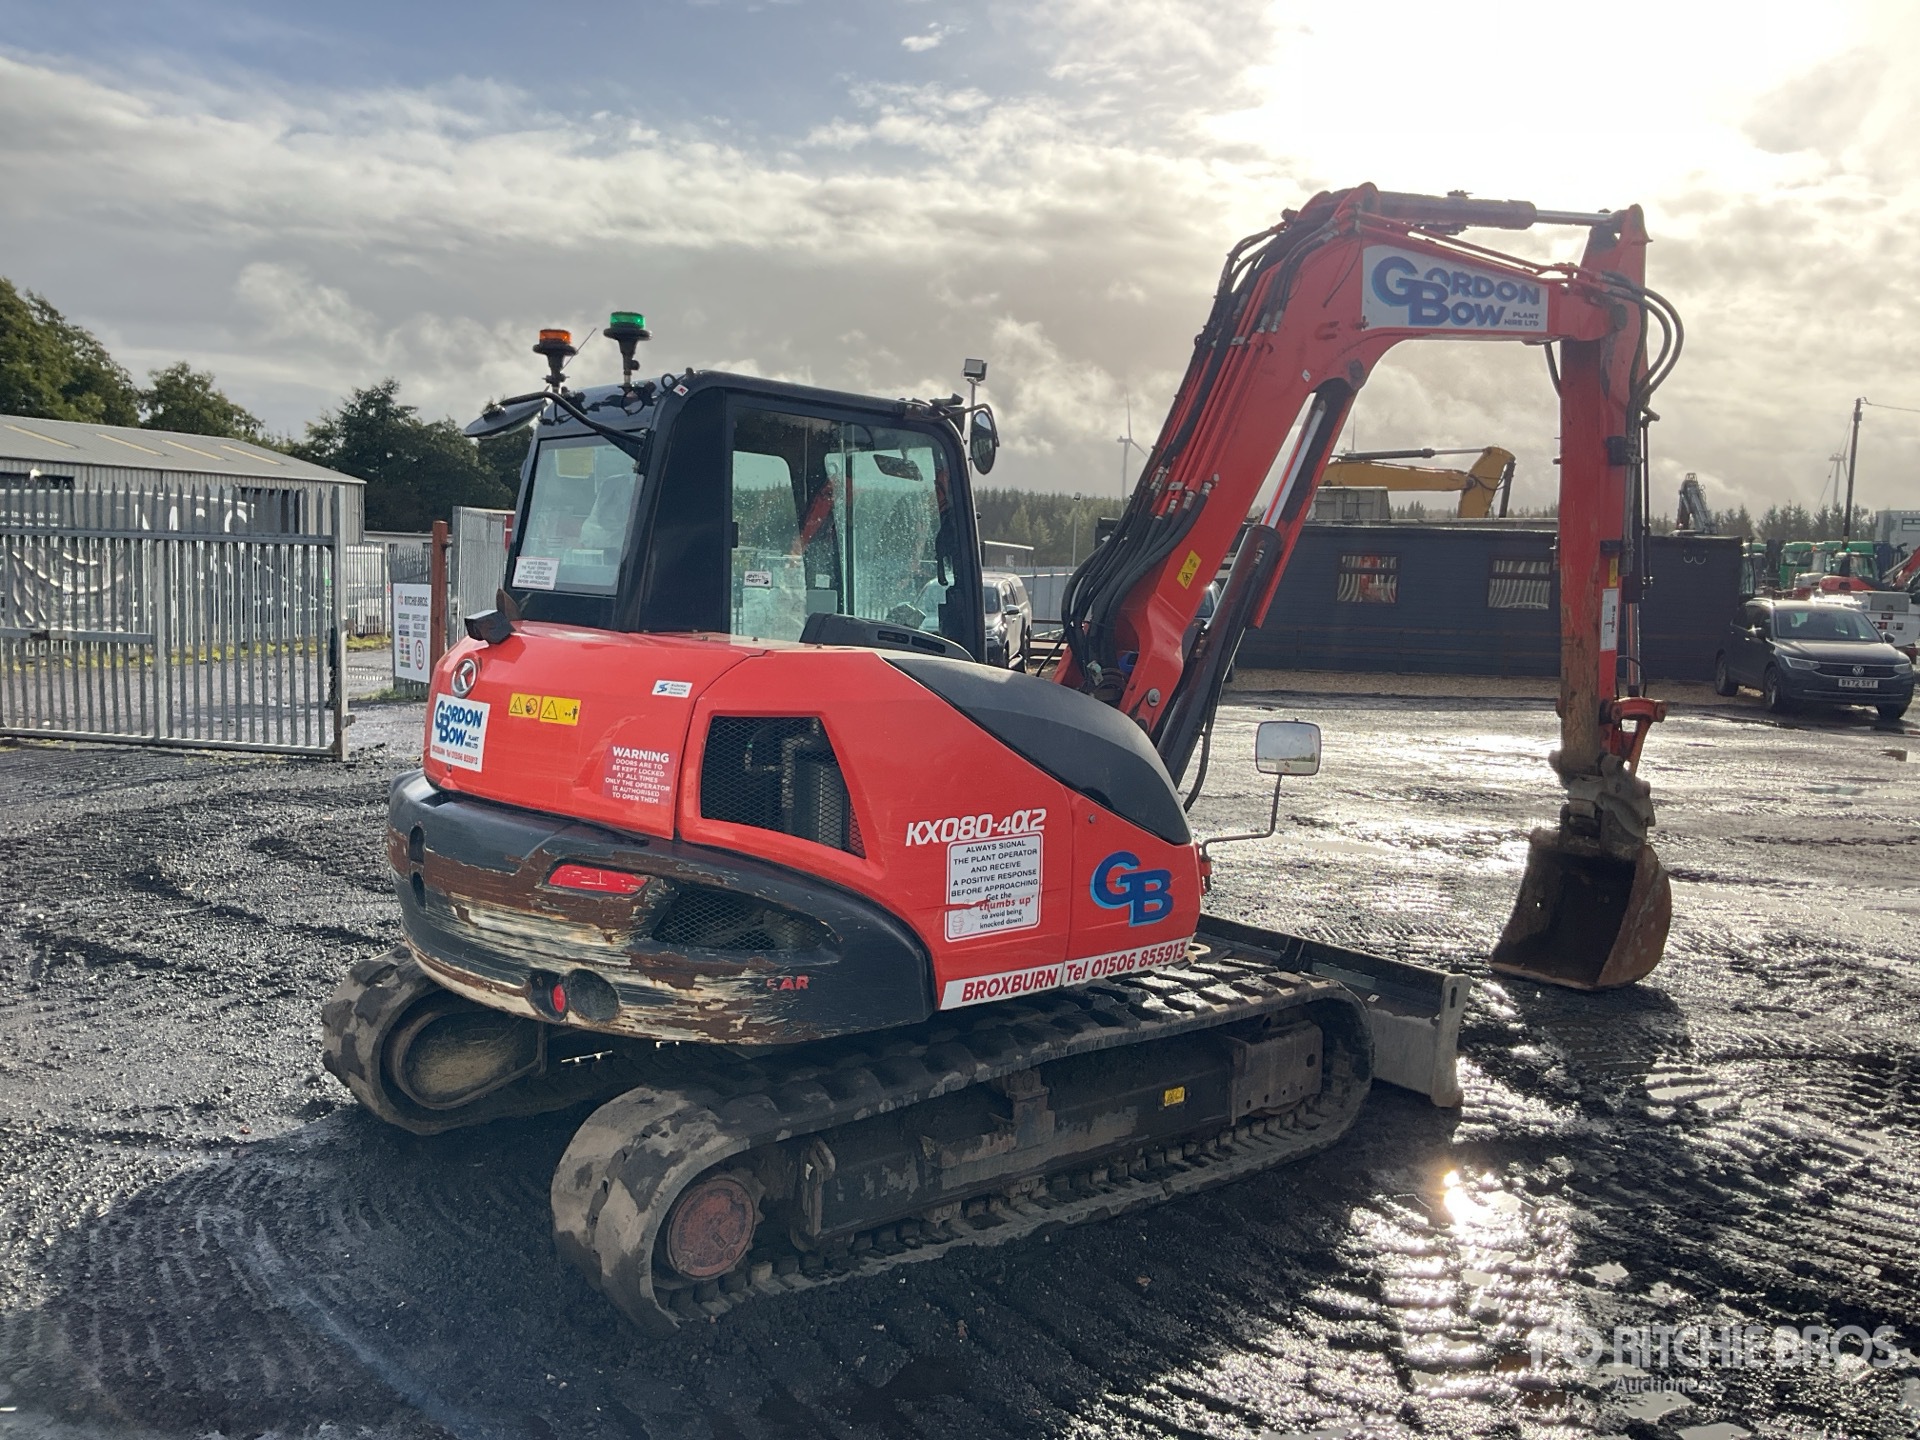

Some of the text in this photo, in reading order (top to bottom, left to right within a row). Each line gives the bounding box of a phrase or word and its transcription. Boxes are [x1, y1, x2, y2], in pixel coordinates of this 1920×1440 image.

[1371, 255, 1540, 307] GORDON
[1405, 277, 1506, 327] BOW
[1512, 311, 1539, 319] PLANT
[435, 700, 483, 729] GORDON
[439, 713, 467, 747] BOW
[612, 746, 670, 764] WARNING
[615, 758, 638, 767] DOORS
[638, 769, 665, 777] LOCKED
[639, 775, 658, 783] TIMES
[605, 777, 671, 791] ONLY THE OPERATOR
[620, 786, 660, 797] AUTHORISED
[622, 793, 639, 801] OPEN
[640, 796, 659, 804] THEM
[965, 840, 1027, 853] ALWAYS SIGNAL
[953, 848, 1038, 865] THE PLANT OPERATOR
[970, 860, 1021, 873] AND RECEIVE
[960, 874, 995, 886] POSITIVE
[997, 868, 1037, 880] RESPONSE
[951, 878, 1038, 897] BEFORE APPROACHING
[1090, 850, 1175, 928] GB
[986, 891, 1012, 901] Get the
[989, 911, 1005, 919] avoid
[1006, 908, 1022, 916] being
[980, 915, 1024, 929] knocked down!
[961, 940, 1188, 1002] BROXBURN Tel 01506 855913
